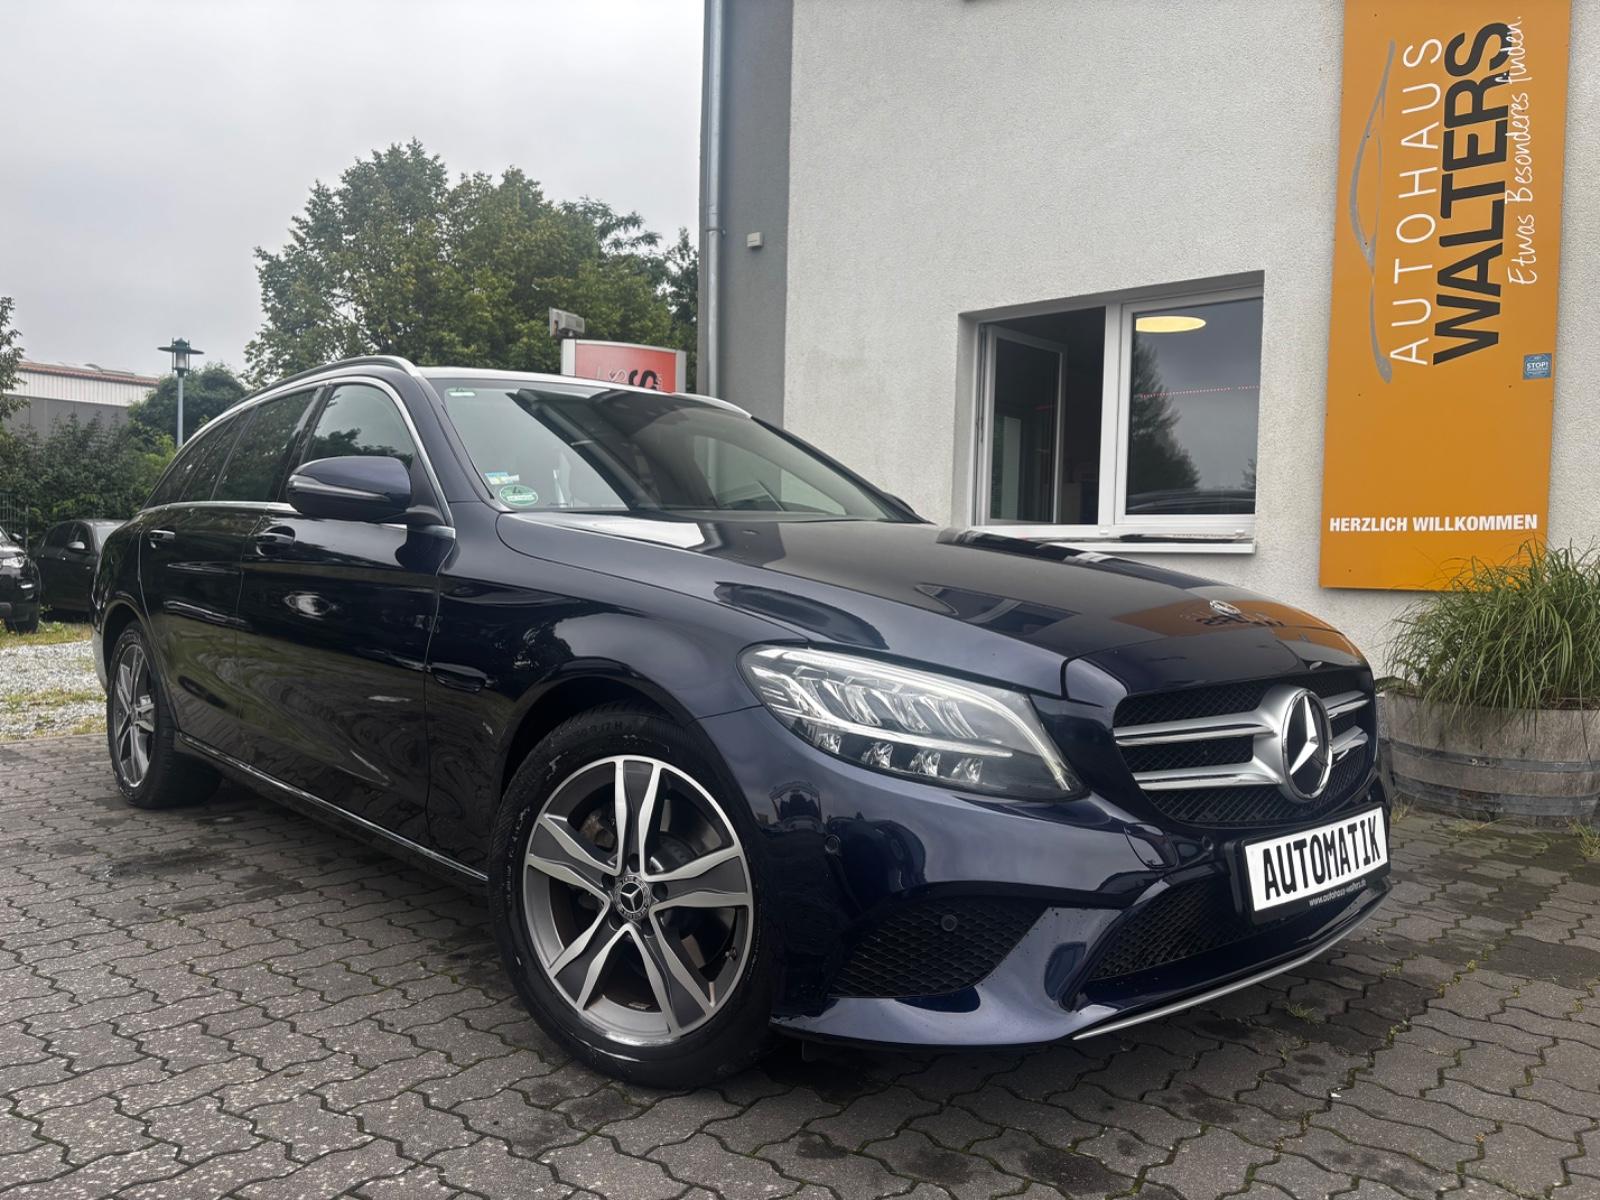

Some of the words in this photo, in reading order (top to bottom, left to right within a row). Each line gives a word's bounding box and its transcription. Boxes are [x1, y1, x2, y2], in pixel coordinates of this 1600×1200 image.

[1495, 16, 1533, 85] finden.
[1504, 92, 1534, 205] Besonderes
[1390, 38, 1443, 366] AUTOHAUS
[1432, 22, 1512, 366] WALTERS
[1507, 213, 1538, 285] Etwas
[1329, 517, 1408, 533] HERZLICH
[1412, 514, 1539, 532] WILLKOMMEN
[1262, 815, 1381, 901] AUTOMATIK
